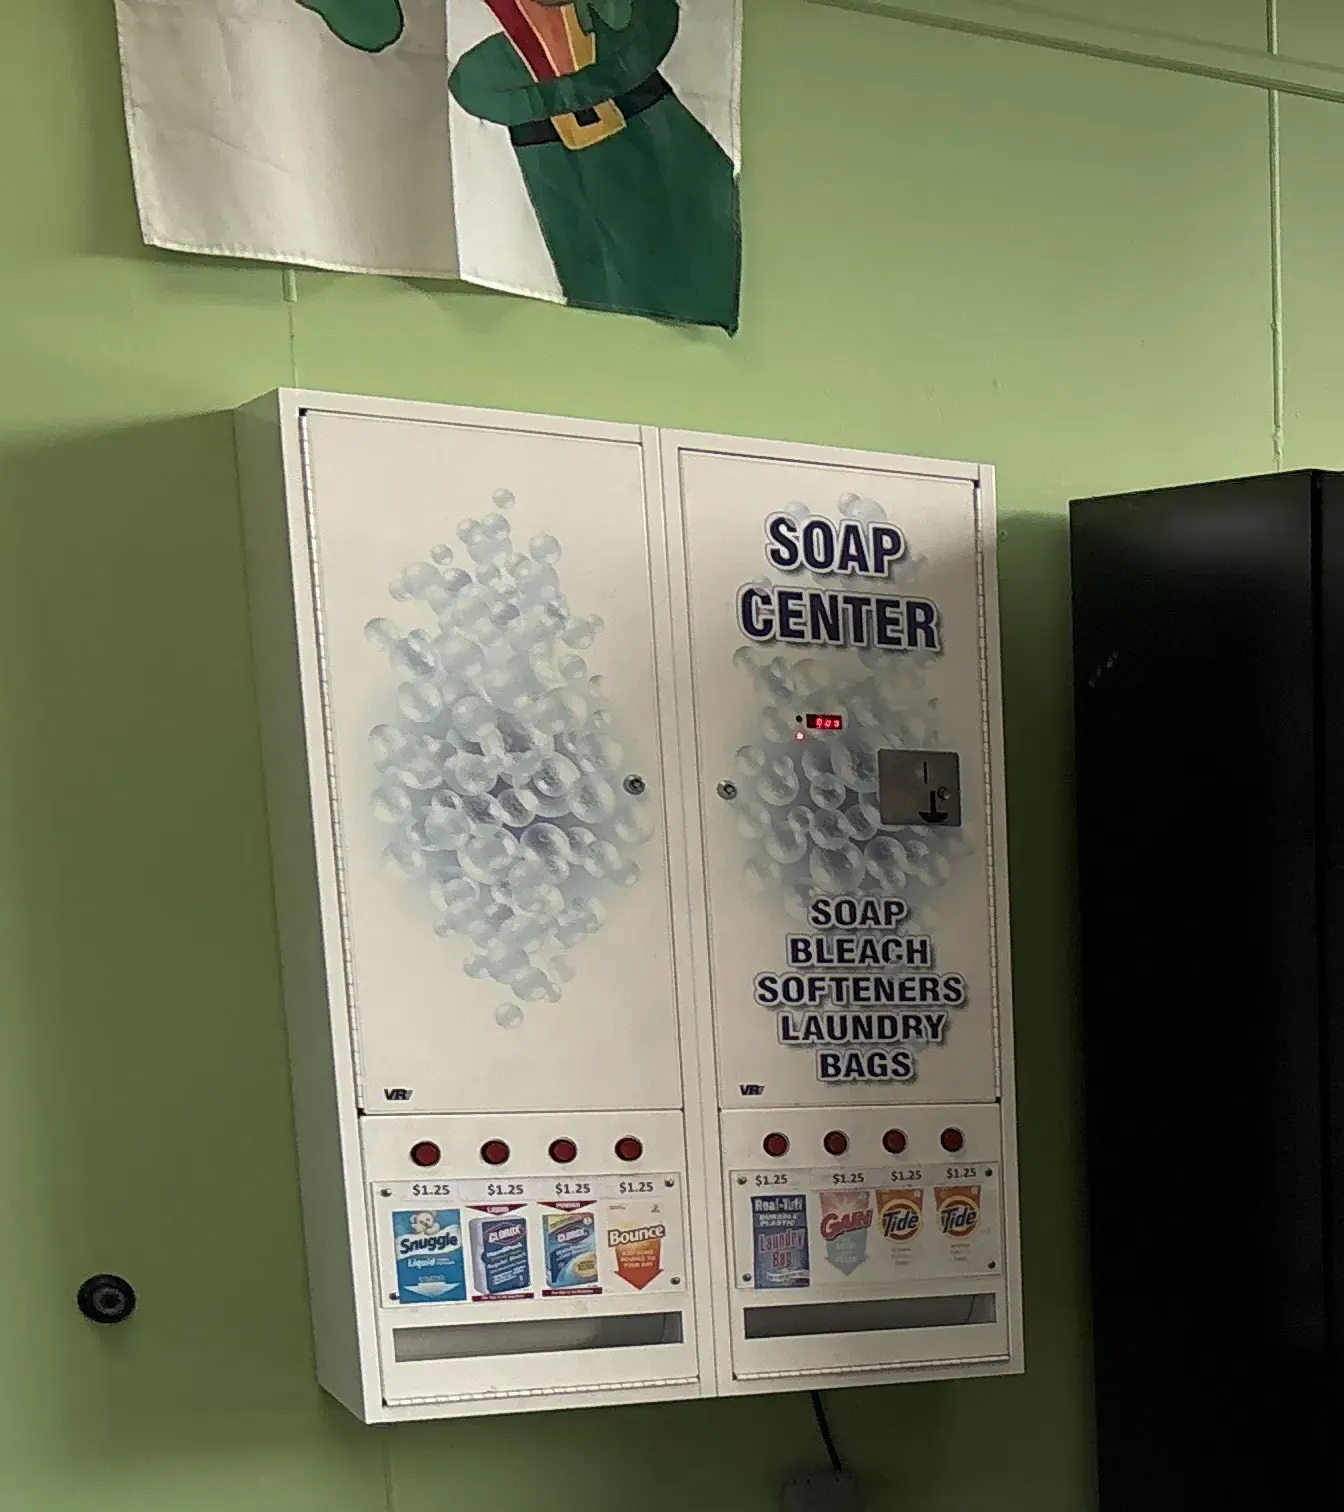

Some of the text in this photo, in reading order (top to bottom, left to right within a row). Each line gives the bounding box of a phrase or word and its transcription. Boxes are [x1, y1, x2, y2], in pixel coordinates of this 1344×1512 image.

[769, 516, 902, 574] SOAP
[741, 587, 939, 649] CENTER
[811, 898, 905, 927] SOAP
[790, 937, 928, 965] BLEACH
[757, 975, 963, 1003] SOFTENERS
[781, 1014, 945, 1041] LAUNDRY
[820, 1052, 911, 1078] BAGS
[755, 1173, 788, 1186] $1.25
[832, 1172, 865, 1185] $1.25
[891, 1169, 922, 1182] $1.25
[946, 1167, 977, 1180] $1.25
[412, 1184, 451, 1196] $1.25
[487, 1183, 524, 1196] $1.25
[555, 1182, 591, 1195] $1.25
[619, 1181, 654, 1193] $1.25
[883, 1210, 919, 1237] Tide
[941, 1207, 977, 1234] Tide
[400, 1232, 458, 1254] Snuggle
[609, 1225, 665, 1246] Bounce
[759, 1228, 805, 1253] Laundry
[772, 1251, 792, 1268] Bag
